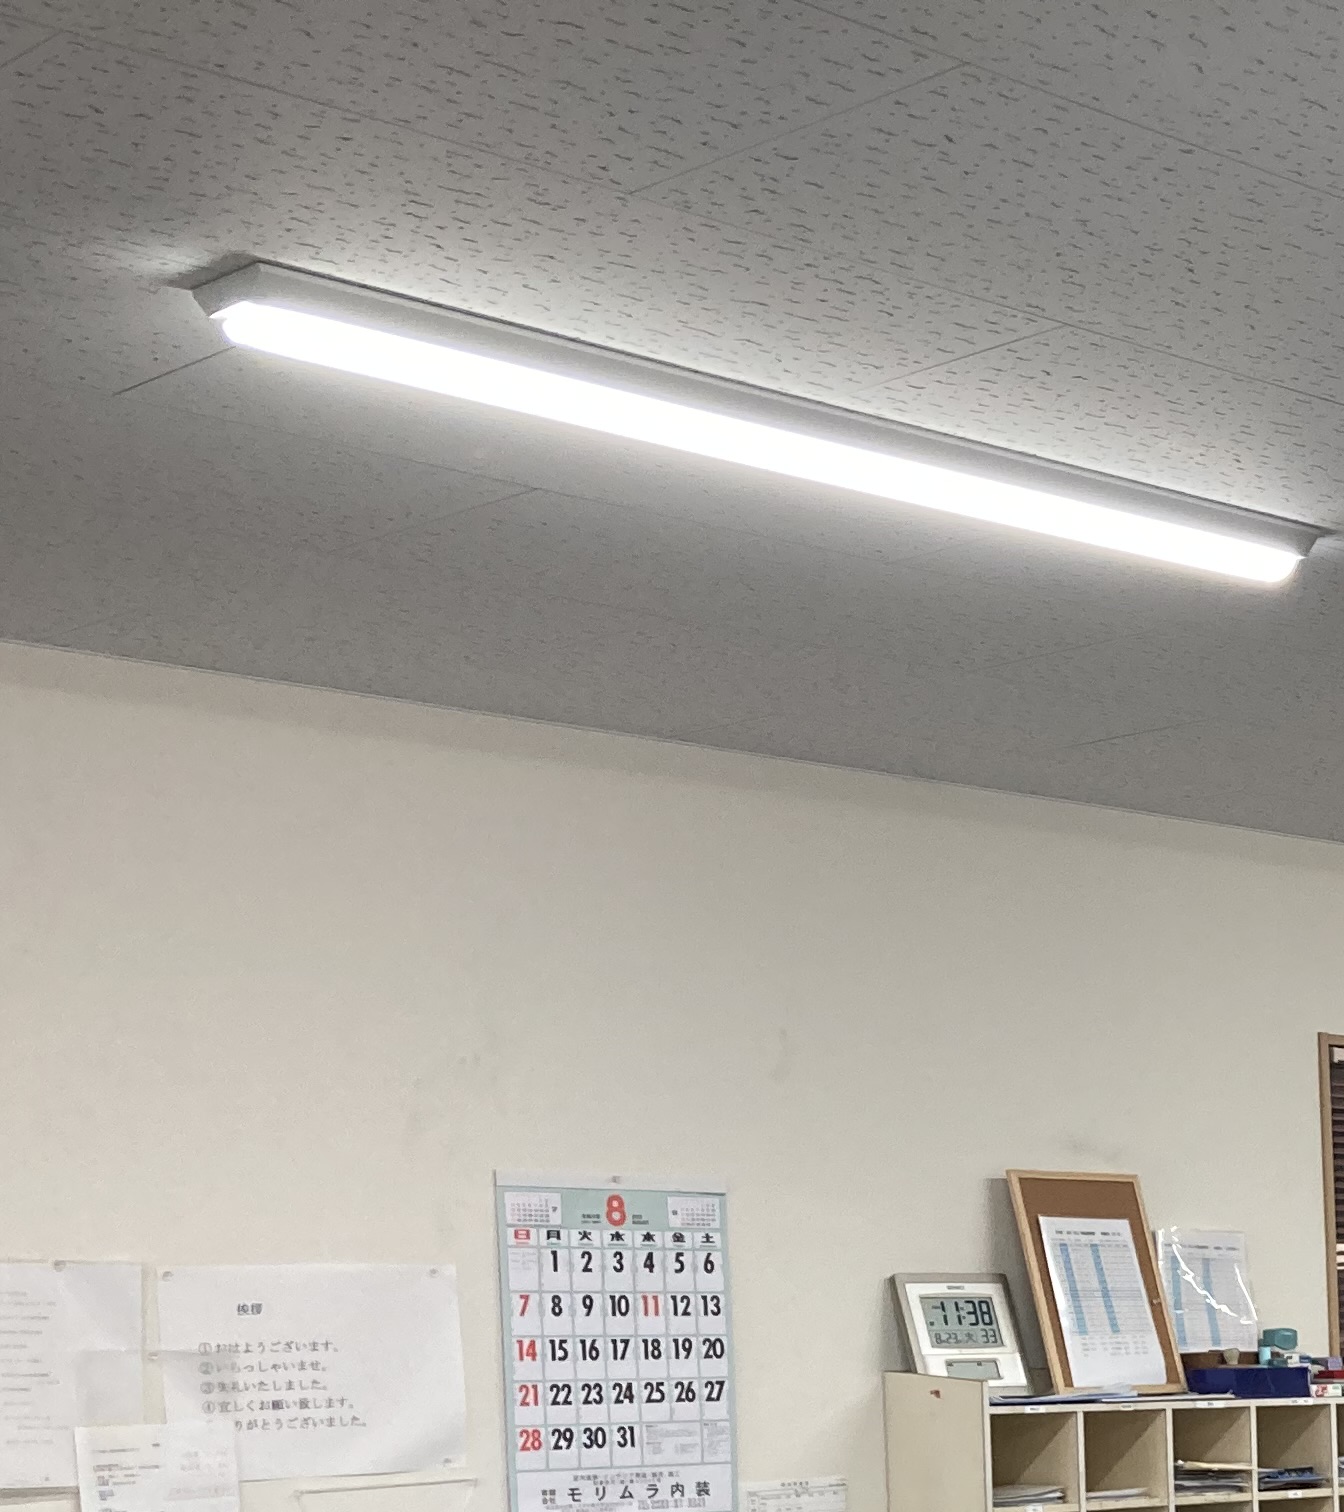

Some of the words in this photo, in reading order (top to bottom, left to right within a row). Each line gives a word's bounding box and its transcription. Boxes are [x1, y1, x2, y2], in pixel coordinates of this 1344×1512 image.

[606, 1193, 627, 1227] 8
[514, 1229, 530, 1240] 日
[546, 1229, 561, 1240] 月
[578, 1230, 592, 1241] 火
[610, 1231, 625, 1242] 水
[672, 1232, 686, 1243] 金
[701, 1233, 716, 1243] 土
[551, 1250, 558, 1272] 1
[581, 1250, 593, 1273] 2
[613, 1251, 624, 1273] 3
[644, 1251, 655, 1273] 4
[674, 1252, 685, 1273] 5
[703, 1253, 715, 1274] 6
[519, 1294, 530, 1316] 7
[551, 1294, 563, 1316] 8
[582, 1294, 594, 1316] 9
[609, 1295, 630, 1317] 10
[641, 1295, 660, 1316] 11
[671, 1295, 691, 1316] 12
[701, 1295, 721, 1316] 13
[981, 1329, 997, 1343] 33
[517, 1339, 537, 1361] 14
[549, 1339, 568, 1361] 15
[580, 1339, 599, 1361] 16
[611, 1339, 630, 1360] 17
[642, 1339, 662, 1360] 18
[673, 1338, 692, 1359] 19
[702, 1338, 724, 1359] 20
[519, 1384, 539, 1407] 21
[550, 1383, 572, 1406] 22
[581, 1383, 603, 1405] 23
[612, 1382, 634, 1404] 24
[644, 1382, 665, 1403] 25
[674, 1381, 696, 1403] 26
[705, 1380, 725, 1402] 27
[519, 1429, 543, 1451] 28
[551, 1428, 574, 1450] 29
[583, 1427, 606, 1449] 30
[617, 1426, 636, 1448] 31
[568, 1481, 711, 1503] モリムラ内装
